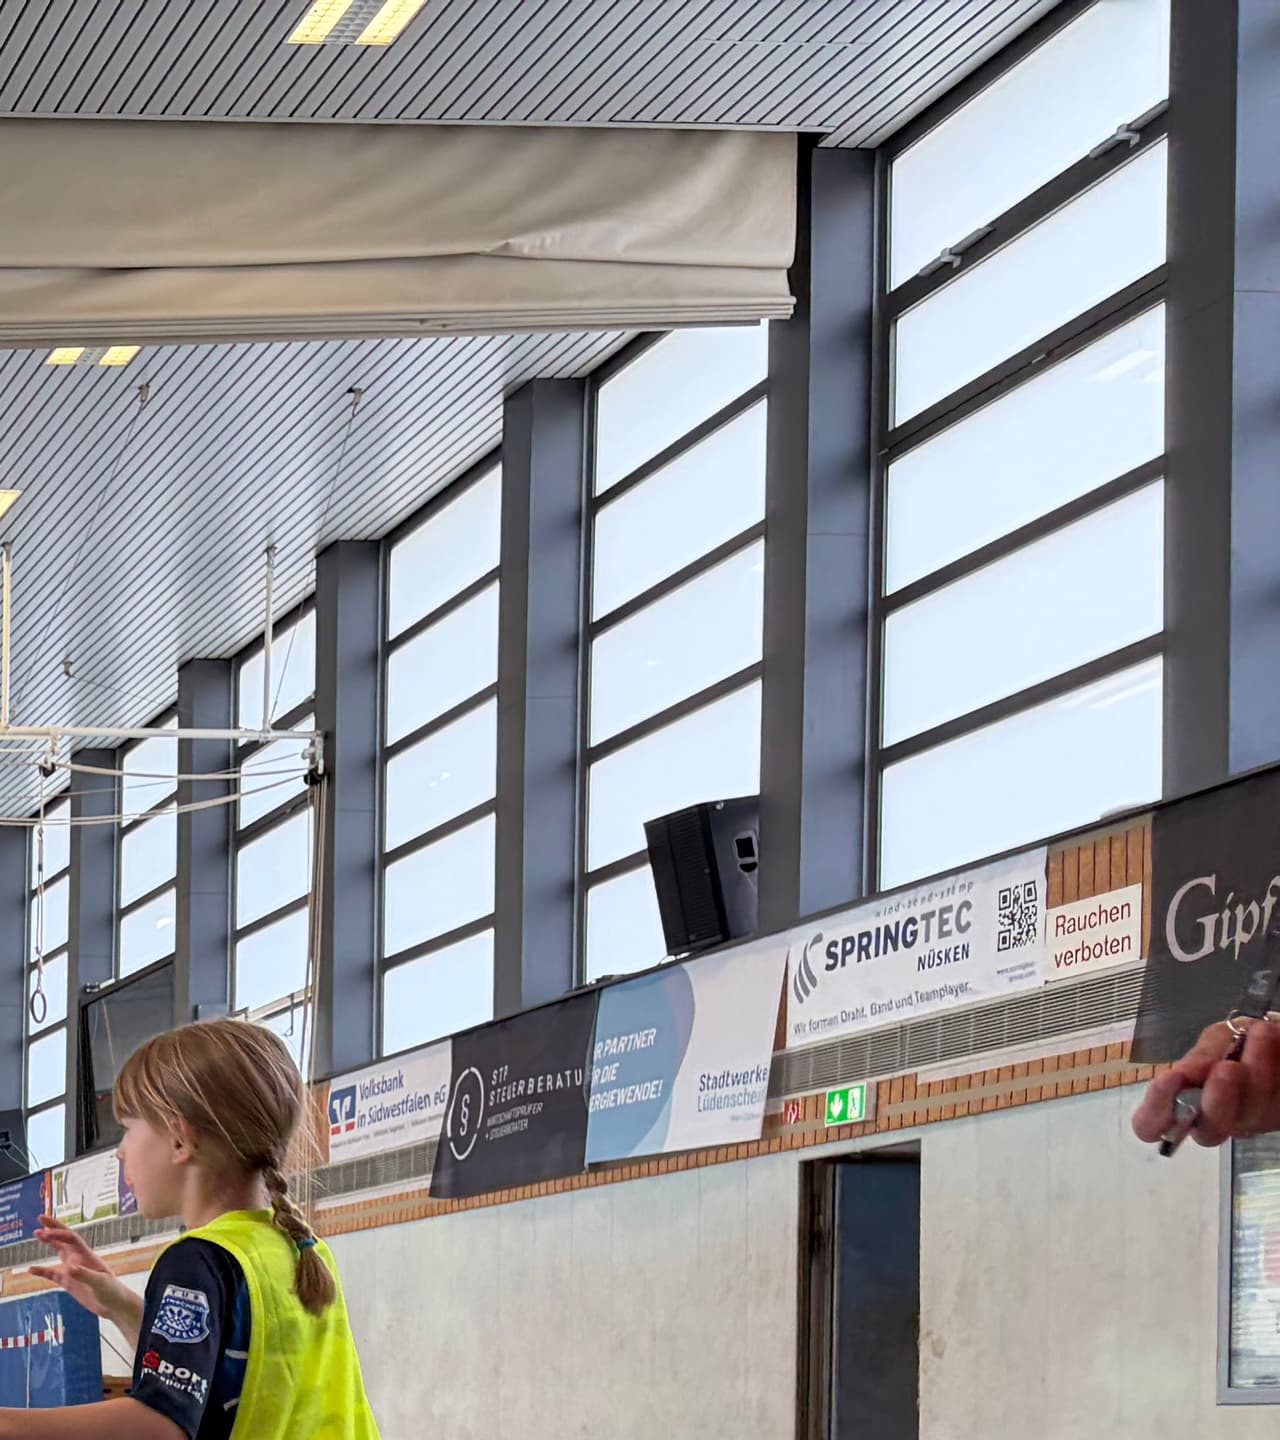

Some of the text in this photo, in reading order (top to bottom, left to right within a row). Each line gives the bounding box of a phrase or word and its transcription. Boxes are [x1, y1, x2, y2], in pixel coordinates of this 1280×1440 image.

[1055, 902, 1131, 937] Rauchen
[825, 900, 972, 972] SPRINGTEC
[1054, 935, 1131, 969] verboten
[917, 942, 970, 972] NÜSKEN
[603, 1028, 657, 1054] PARTNER
[359, 1069, 405, 1101] Volksbank
[600, 1062, 620, 1083] DIE
[699, 1064, 768, 1092] Stadtwerke
[357, 1110, 366, 1129] in
[367, 1092, 432, 1126] Südwestfalen
